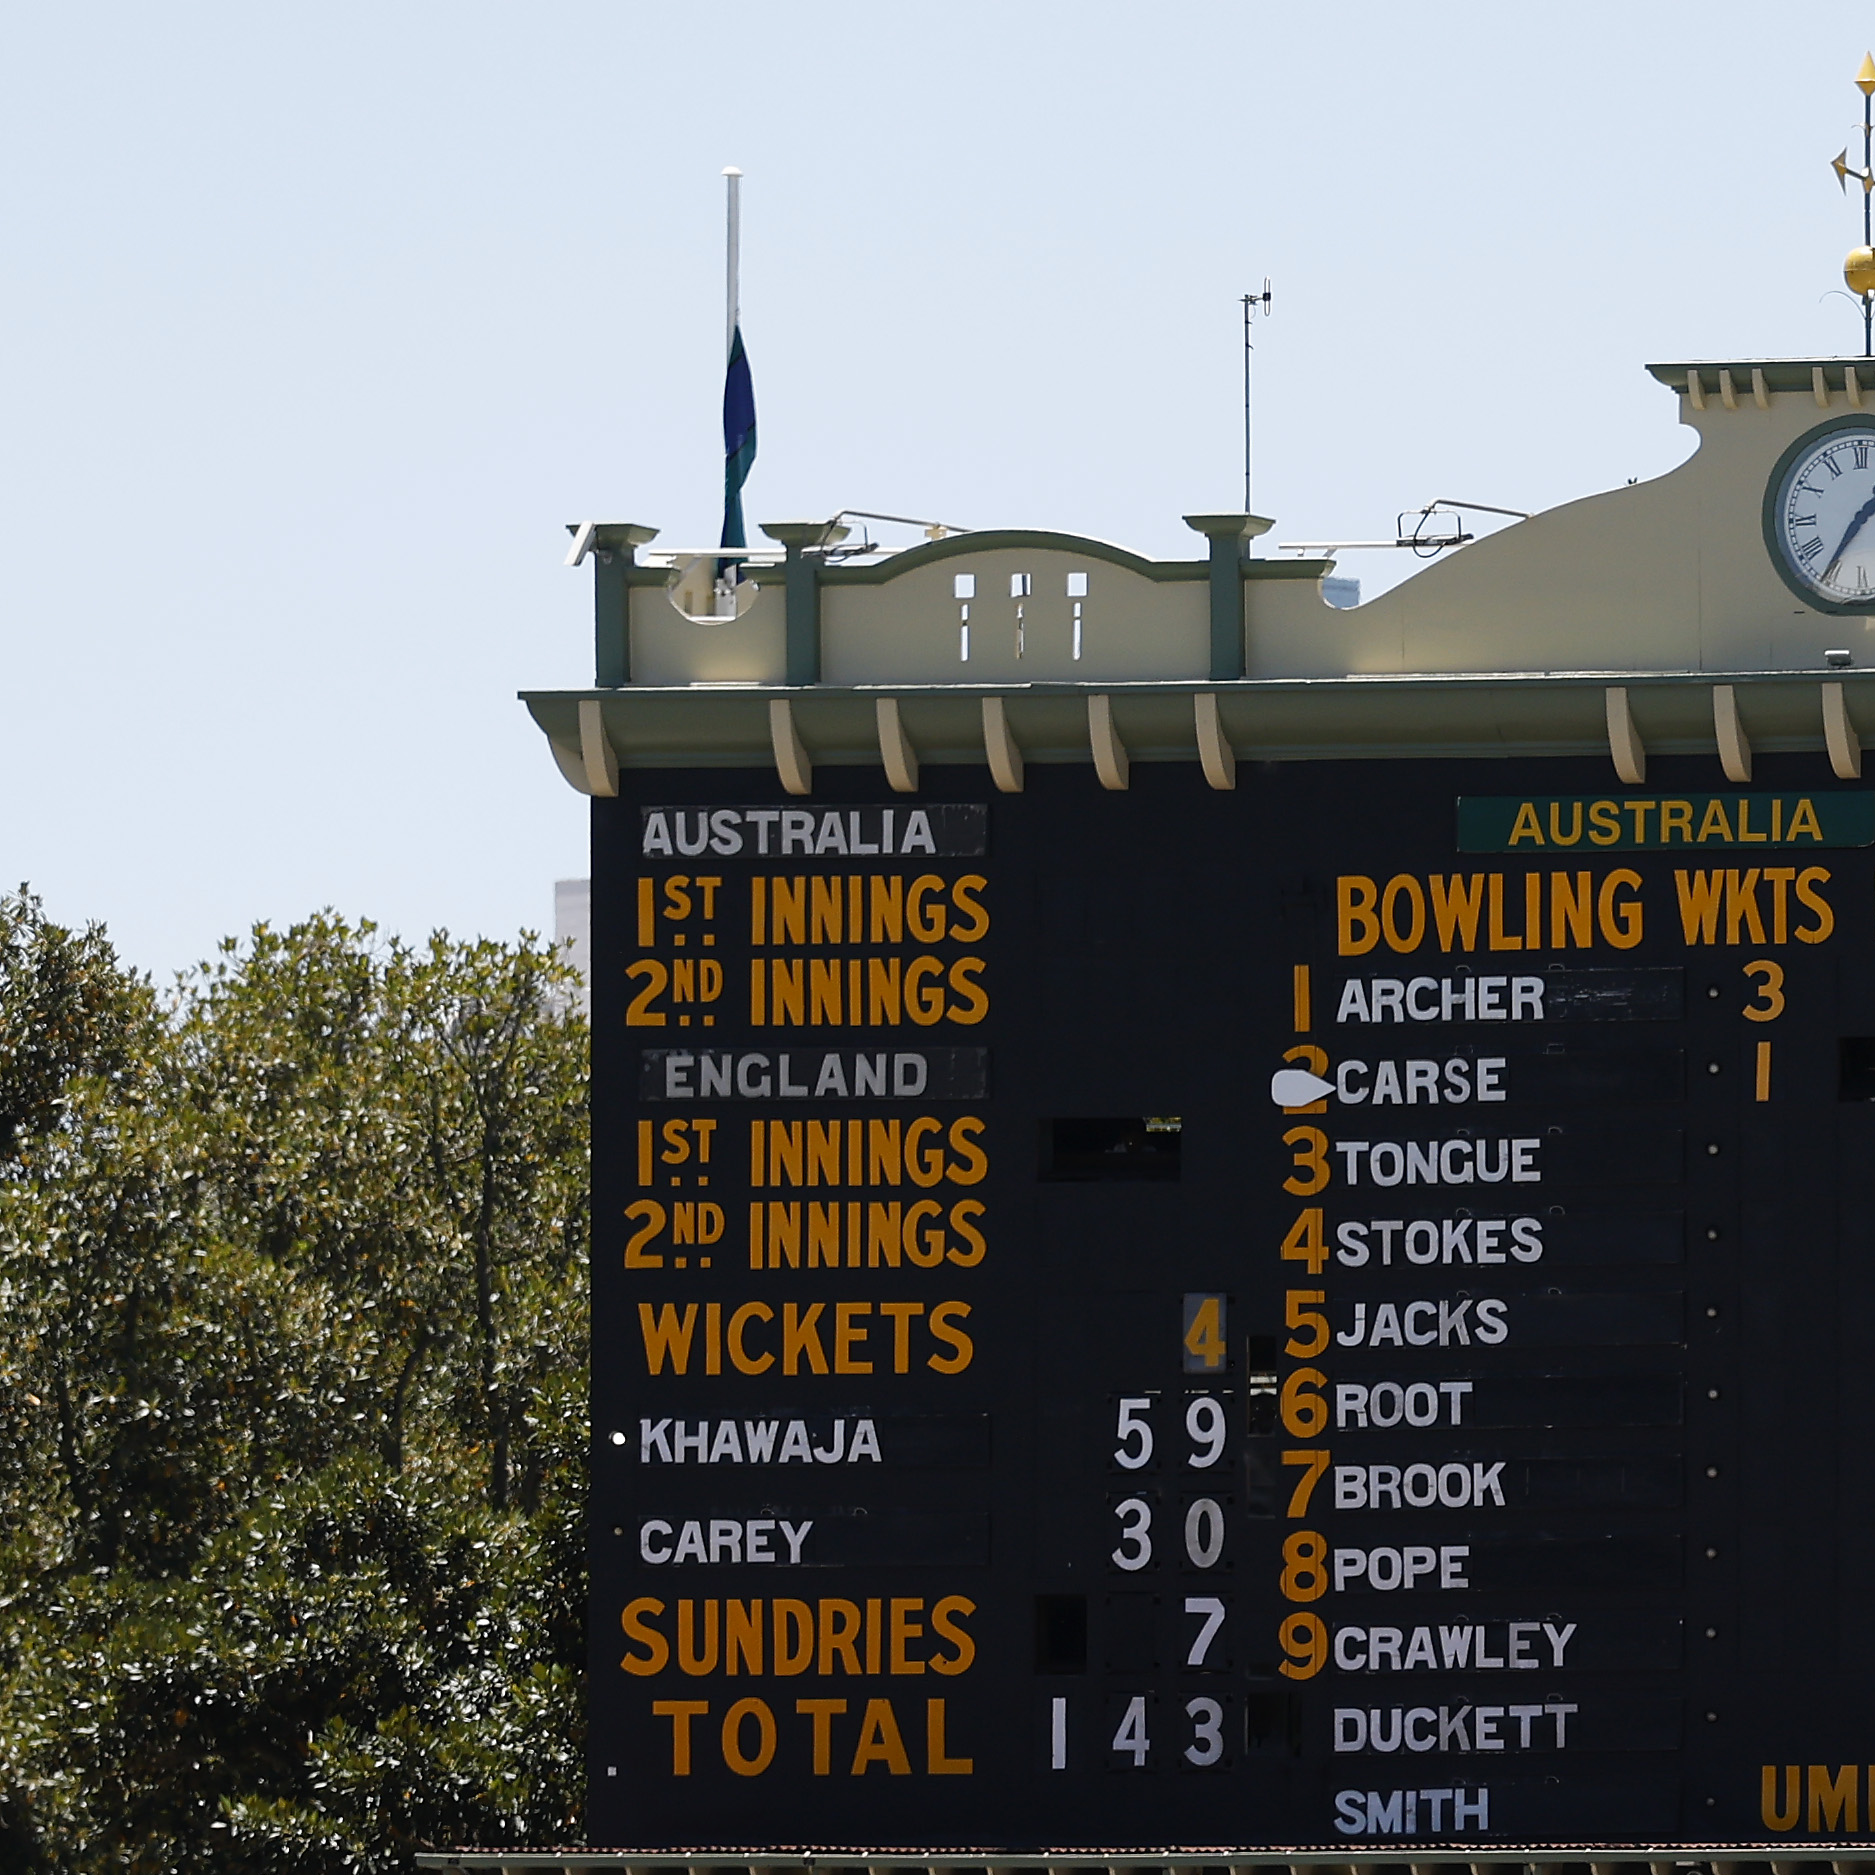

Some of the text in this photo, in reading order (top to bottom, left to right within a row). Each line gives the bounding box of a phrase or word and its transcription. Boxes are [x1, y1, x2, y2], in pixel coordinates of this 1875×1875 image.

[642, 809, 937, 856] AUSTRALIA
[1508, 798, 1824, 846] AUSTRALIA
[751, 874, 990, 946] INNINGS
[1336, 868, 1643, 957] BOWLING
[1674, 866, 1835, 946] WKTS
[751, 955, 989, 1026] INNINGS
[1293, 959, 1785, 1033] 1 ARCHER 3
[665, 1052, 928, 1098] ENGLAND
[1336, 1057, 1506, 1105] CARSE
[1755, 1041, 1771, 1102] 1
[751, 1116, 988, 1188] INNINGS
[1282, 1125, 1541, 1197] 3 TONGUE
[749, 1199, 987, 1270] INNINGS
[1280, 1207, 1543, 1275] 4 STOKES
[637, 1297, 1227, 1376] WICKETS 4
[1284, 1289, 1330, 1359] 5
[1336, 1298, 1509, 1347] JACKS
[1279, 1367, 1473, 1439] 6 ROOT
[639, 1418, 882, 1464] KHAWAJA
[1281, 1449, 1506, 1518] 7 BROOK
[640, 1519, 814, 1564] CAREY
[1279, 1530, 1470, 1603] 8 POPE
[620, 1595, 1226, 1677] SUNDRIES 7
[1278, 1611, 1577, 1681] 9 CRAWLEY
[652, 1697, 973, 1777] TOTAL
[1333, 1703, 1578, 1753] DUCKETT
[1333, 1787, 1489, 1835] SMITH
